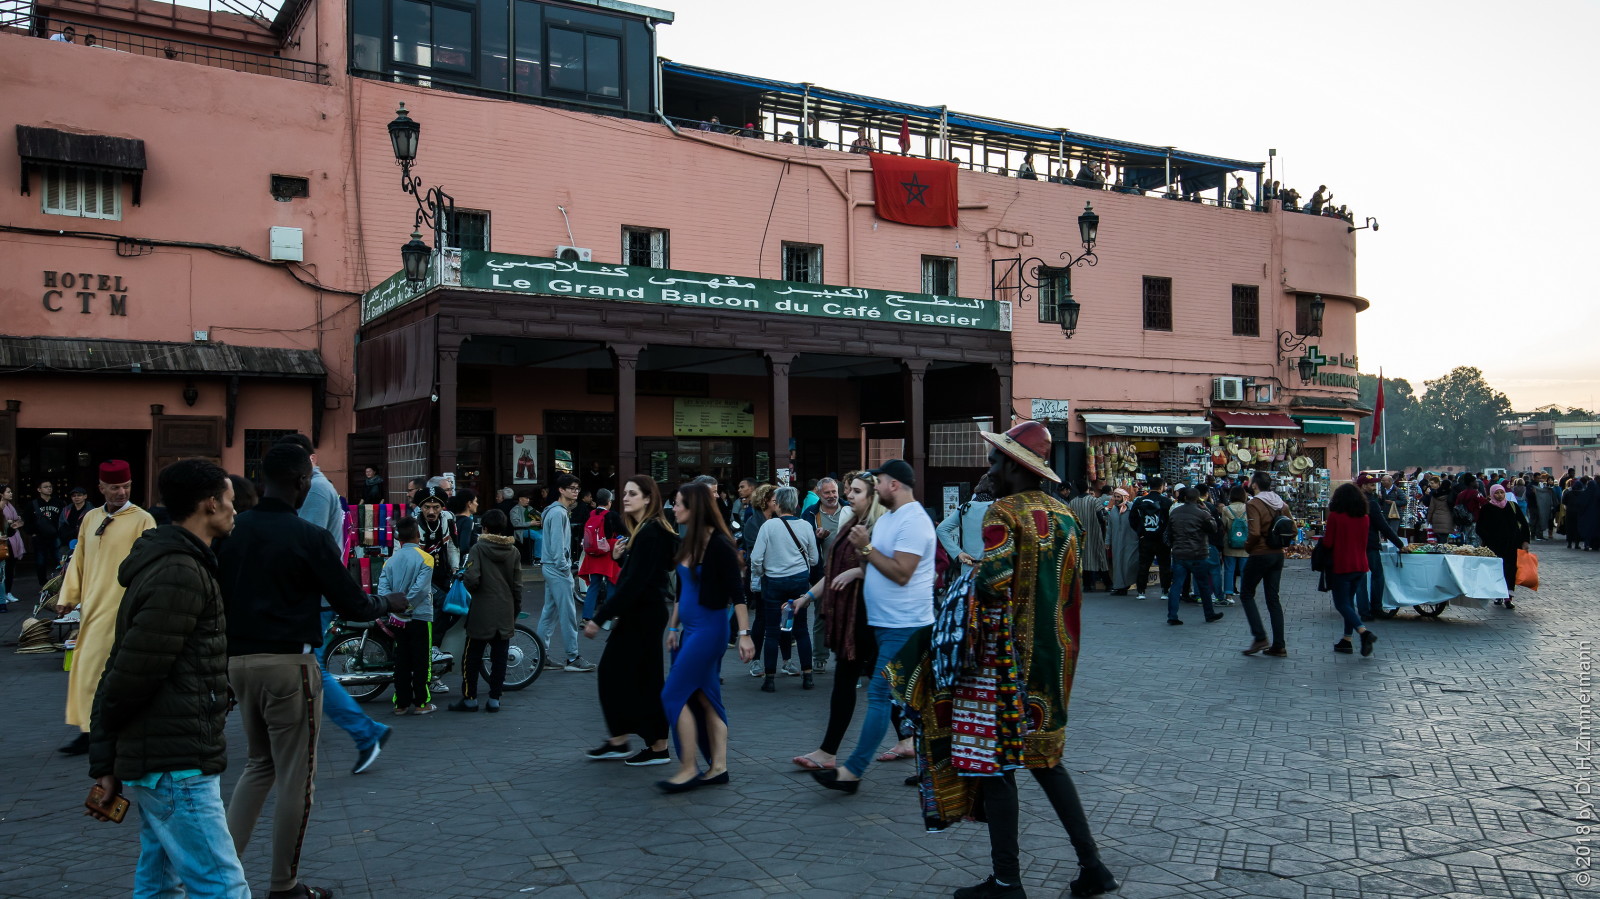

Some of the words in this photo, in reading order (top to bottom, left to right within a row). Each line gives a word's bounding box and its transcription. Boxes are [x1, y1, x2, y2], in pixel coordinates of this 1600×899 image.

[43, 270, 128, 292] HOTEL
[648, 275, 756, 289] مقهى
[492, 274, 531, 289] Le
[548, 279, 645, 299] Grand
[661, 289, 759, 309] Balcon
[775, 299, 809, 313] du
[822, 303, 881, 318] Café
[893, 309, 981, 326] Glacier
[774, 285, 869, 299] الكبير
[42, 289, 128, 317] CTM
[1133, 425, 1169, 435] DURACELL
